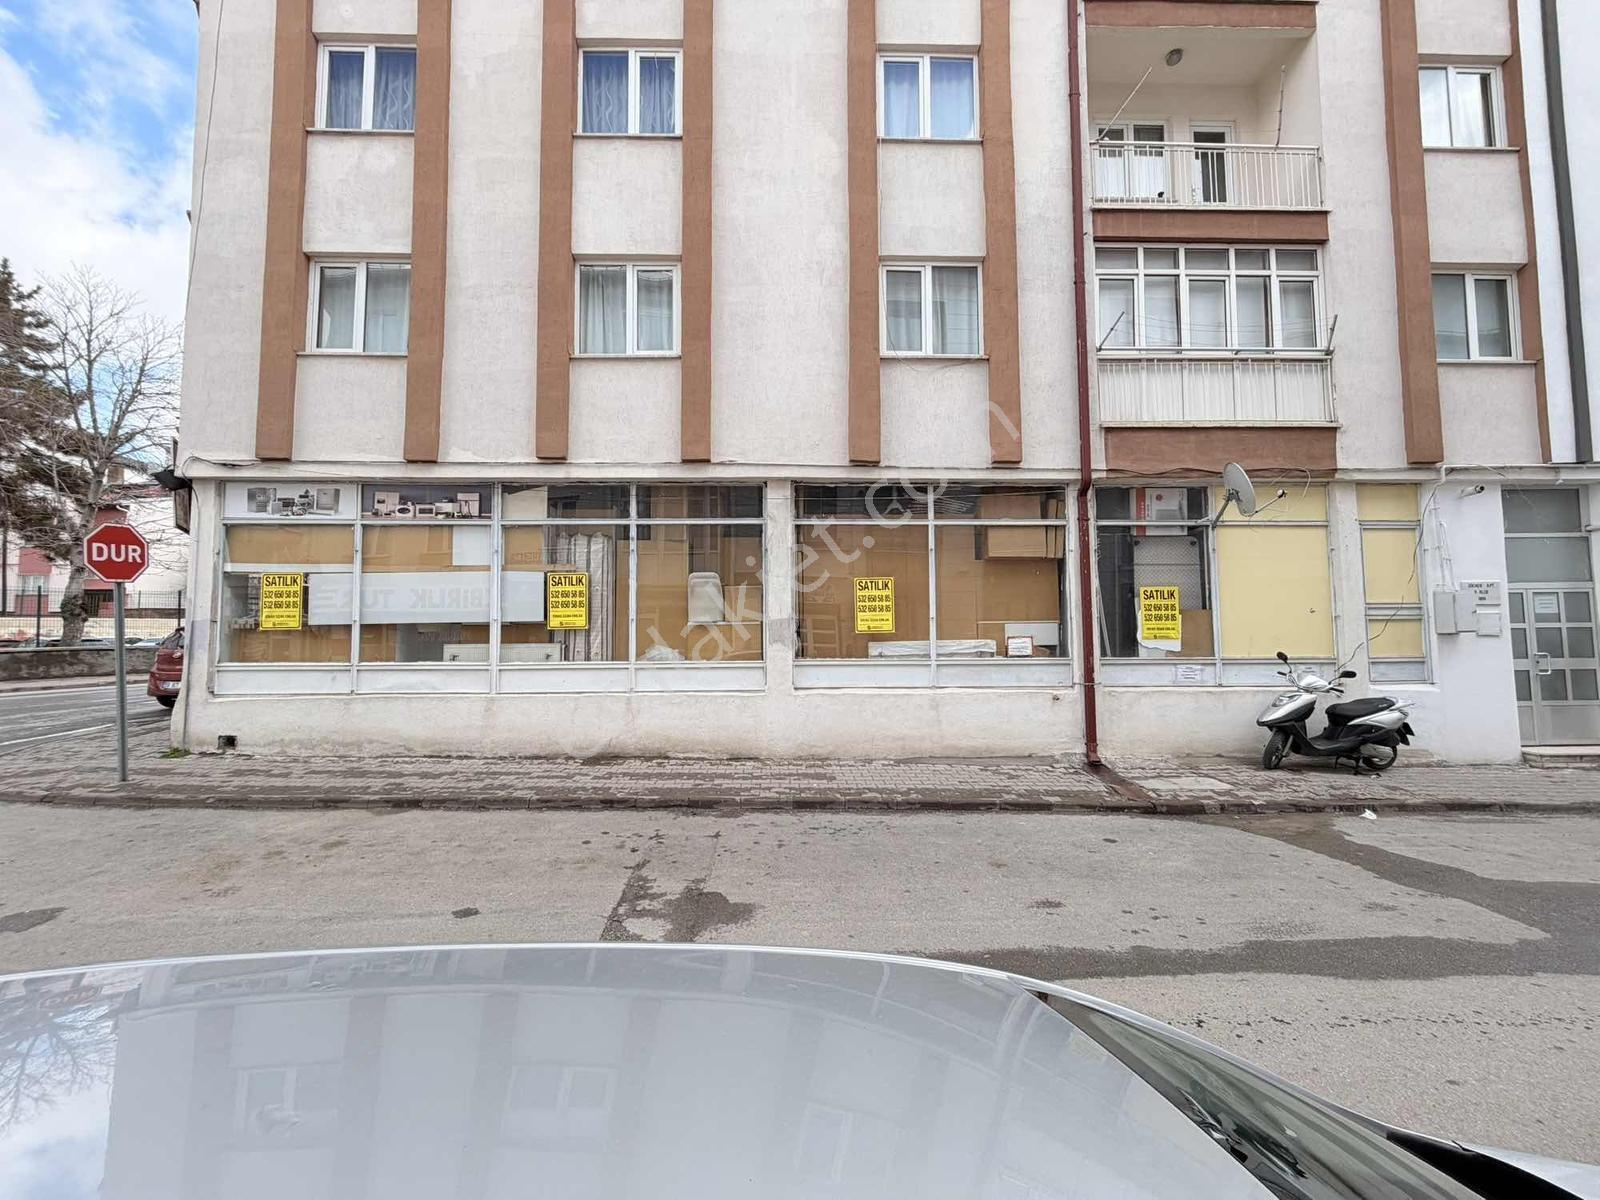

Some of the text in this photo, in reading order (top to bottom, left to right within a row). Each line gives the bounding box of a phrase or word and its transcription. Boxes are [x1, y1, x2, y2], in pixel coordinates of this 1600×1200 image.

[92, 542, 142, 563] DUR
[265, 576, 299, 586] SATILIK
[551, 576, 584, 586] SATILIK
[858, 581, 890, 591] SATILIK
[551, 590, 584, 598] 532 650 58 85
[858, 594, 891, 603] 532 650 58 85
[1143, 590, 1176, 600] SATILIK
[551, 600, 584, 608] 532 650 58 85
[858, 604, 891, 613] 532 650 58 85
[1144, 603, 1176, 612] 532 650 58 85
[1144, 614, 1177, 622] 532 650 58 85
